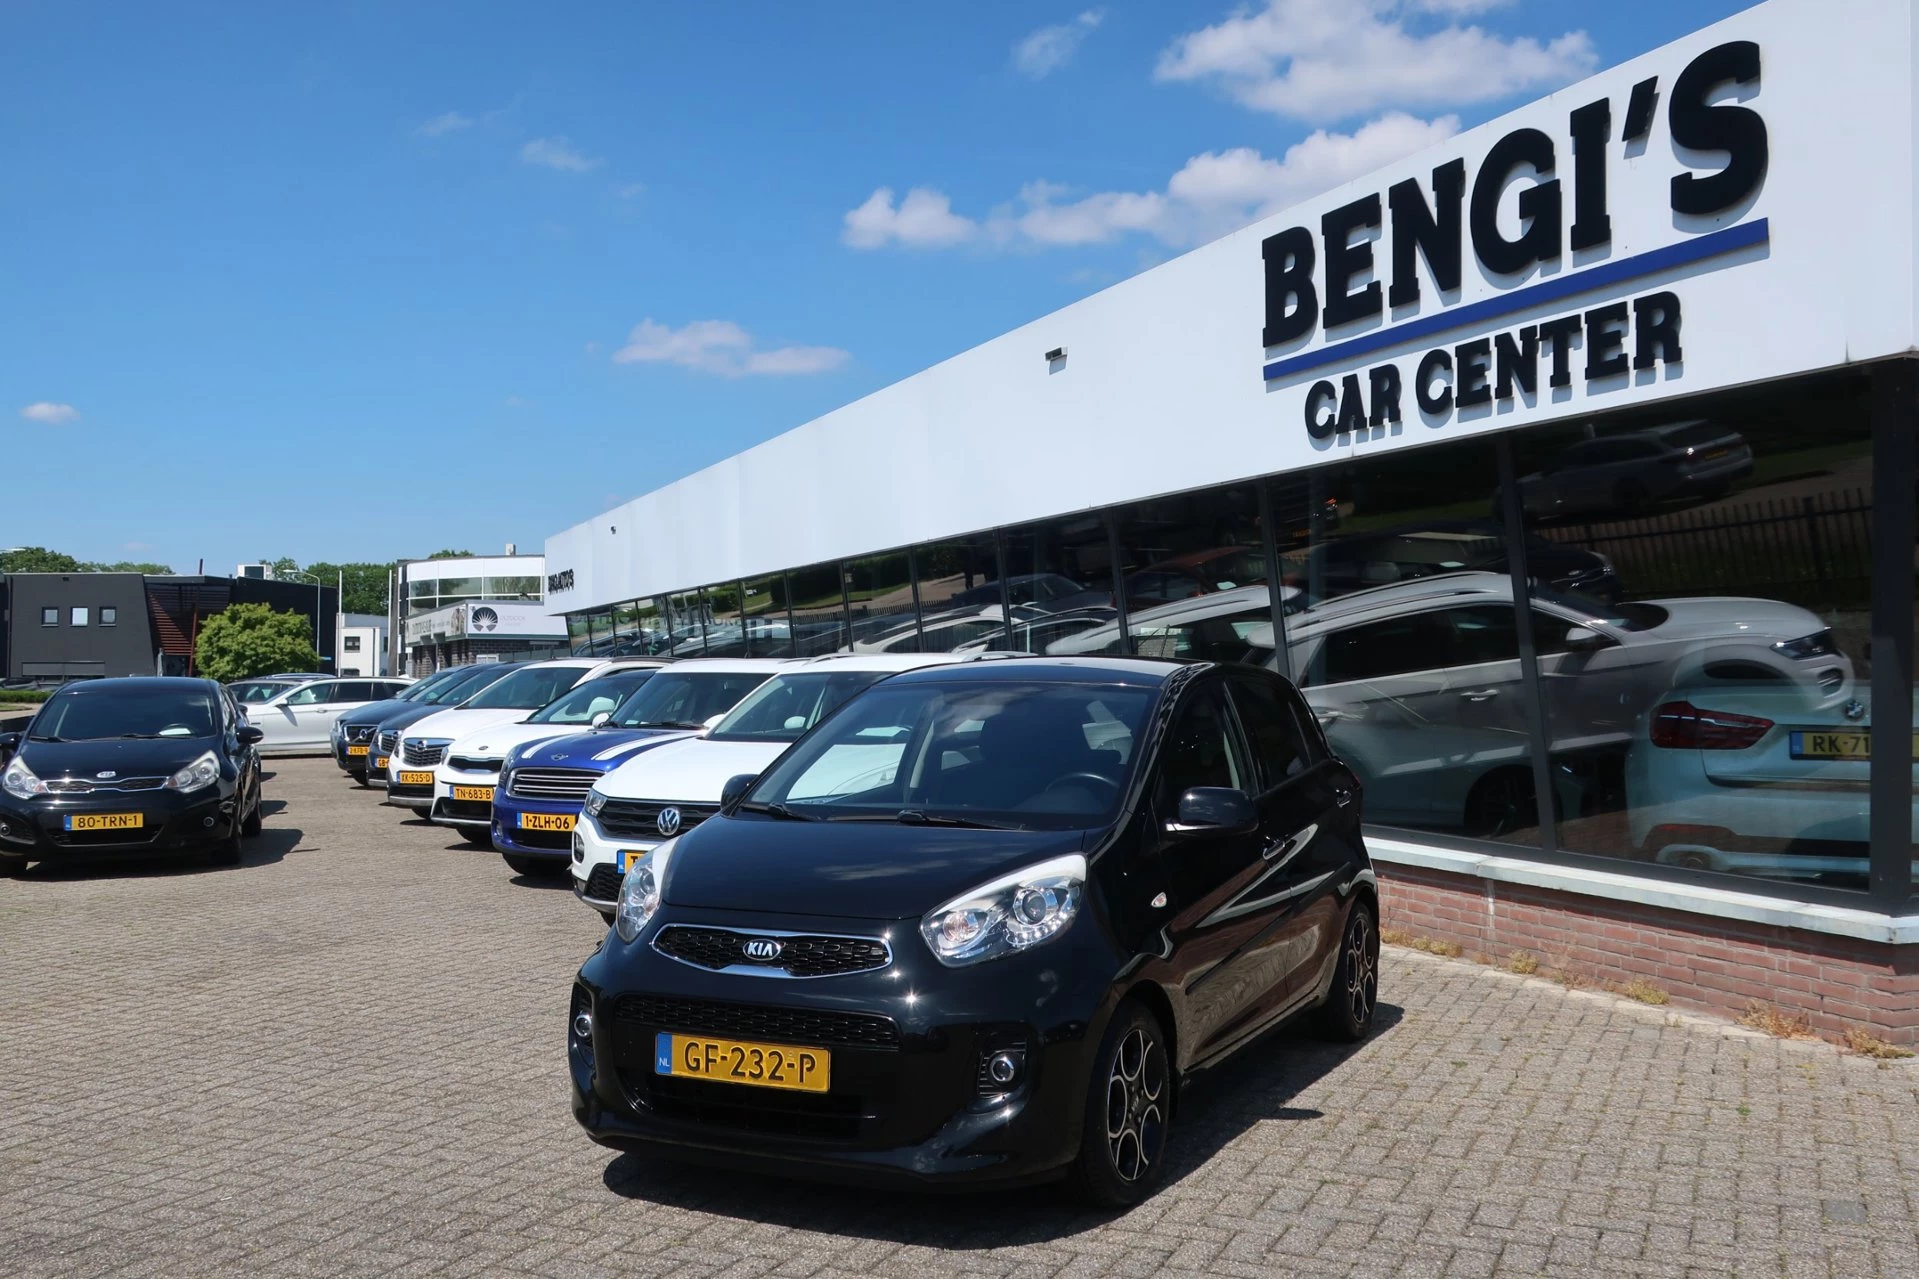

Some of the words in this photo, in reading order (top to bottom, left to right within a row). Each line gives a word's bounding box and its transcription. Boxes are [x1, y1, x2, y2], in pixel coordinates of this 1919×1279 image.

[1262, 40, 1768, 348] BENGI'S
[1305, 363, 1402, 439] CAR
[1416, 291, 1683, 415] CENTER
[378, 759, 389, 767] GB-
[455, 788, 491, 800] TN-683-B
[77, 815, 138, 828] 80-TRN-1
[525, 815, 570, 830] 1-ZLH-06
[747, 942, 773, 957] KIA
[659, 1057, 670, 1067] NL
[684, 1041, 816, 1083] GF-232-P
